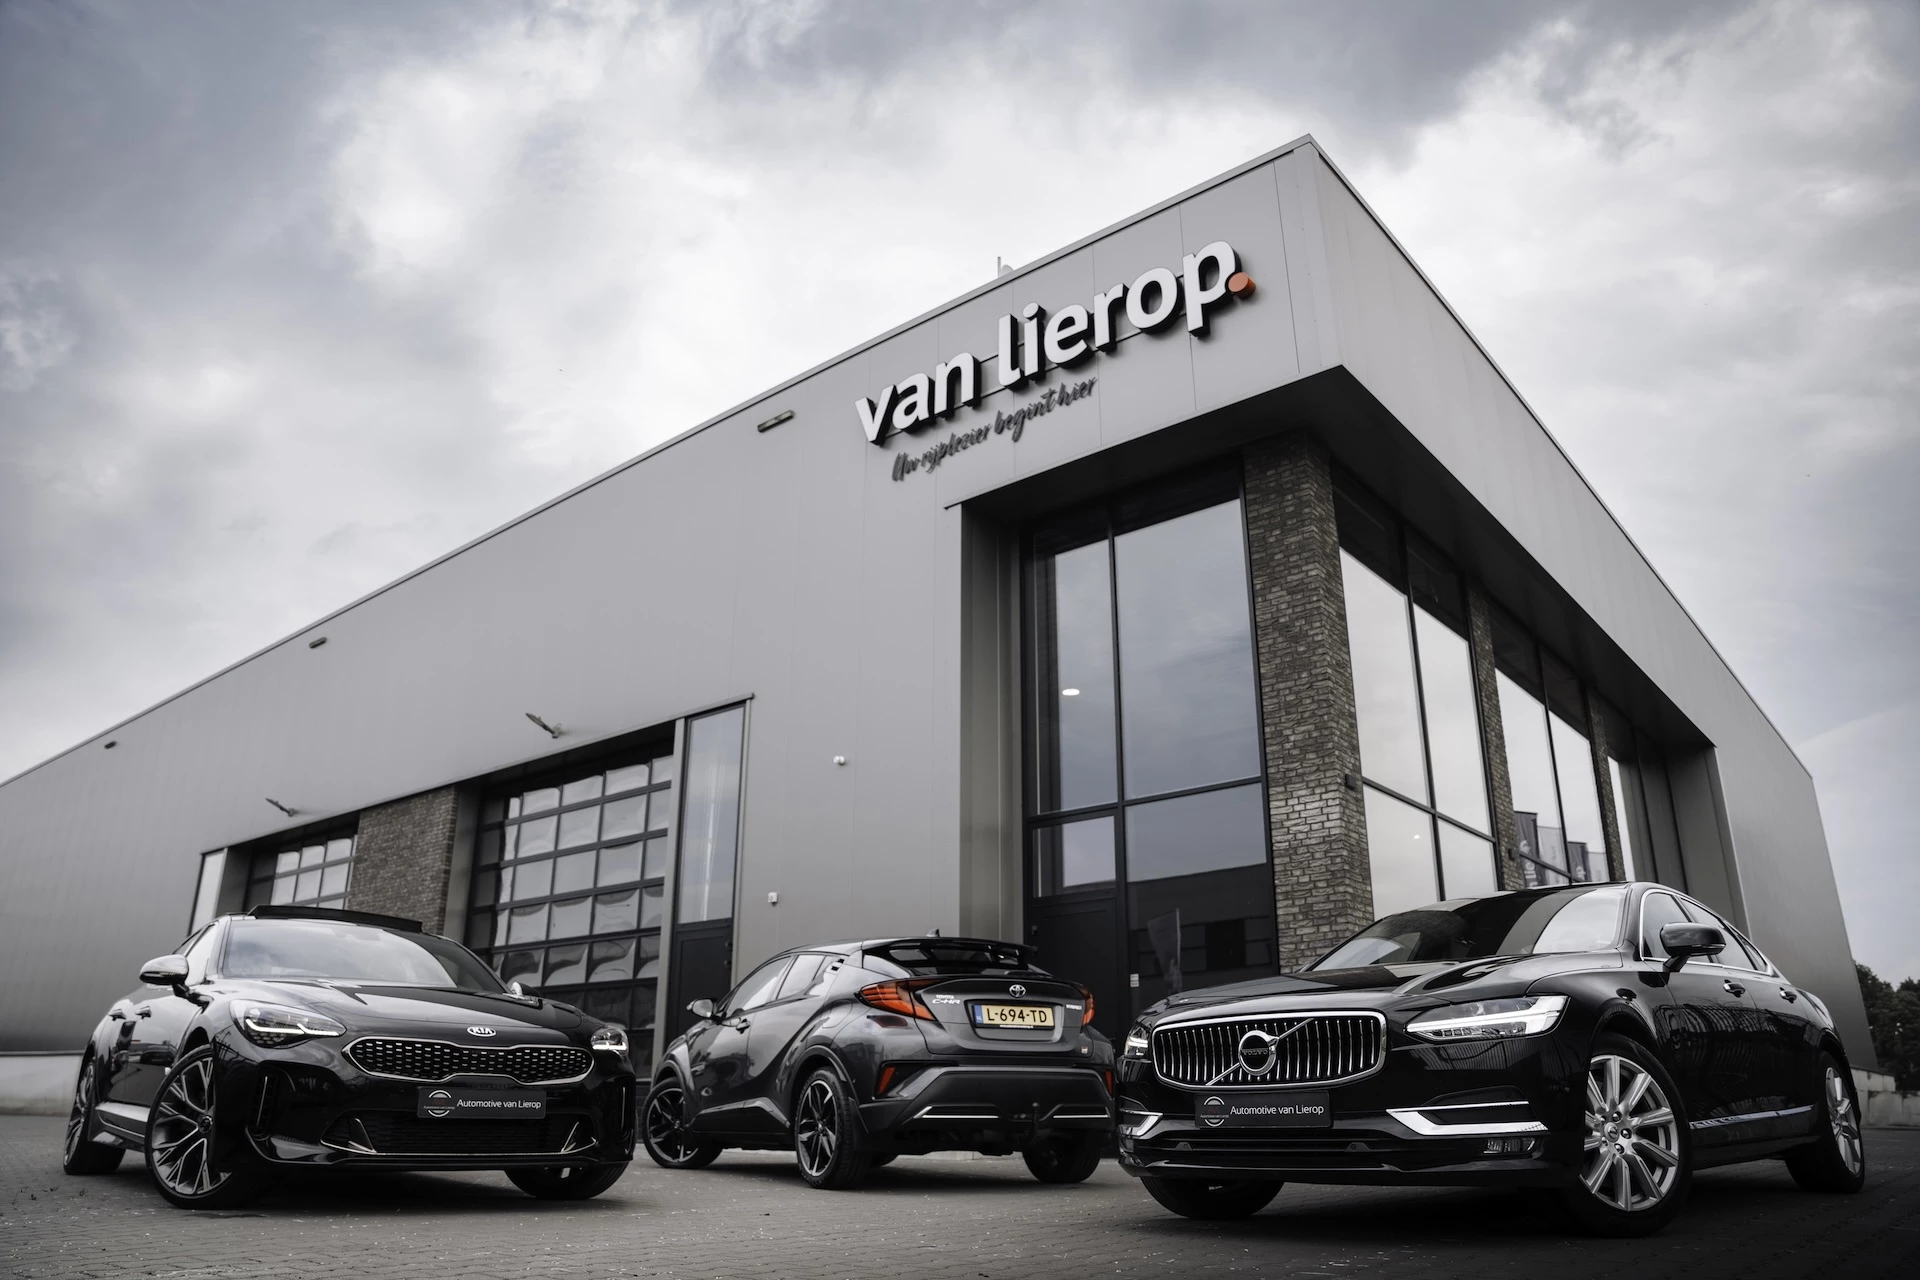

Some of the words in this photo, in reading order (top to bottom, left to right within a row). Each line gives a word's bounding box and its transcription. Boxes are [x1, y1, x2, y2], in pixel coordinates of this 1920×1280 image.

[855, 352, 979, 443] van
[994, 388, 1057, 443] begint
[1056, 377, 1098, 407] hier
[986, 1008, 1047, 1023] L-694-TD
[470, 1027, 494, 1035] KIA
[456, 1099, 502, 1108] Automotive
[518, 1100, 542, 1110] Lierop
[1230, 1105, 1277, 1115] Automotive
[1278, 1106, 1294, 1114] van
[1296, 1104, 1325, 1116] Lierop
